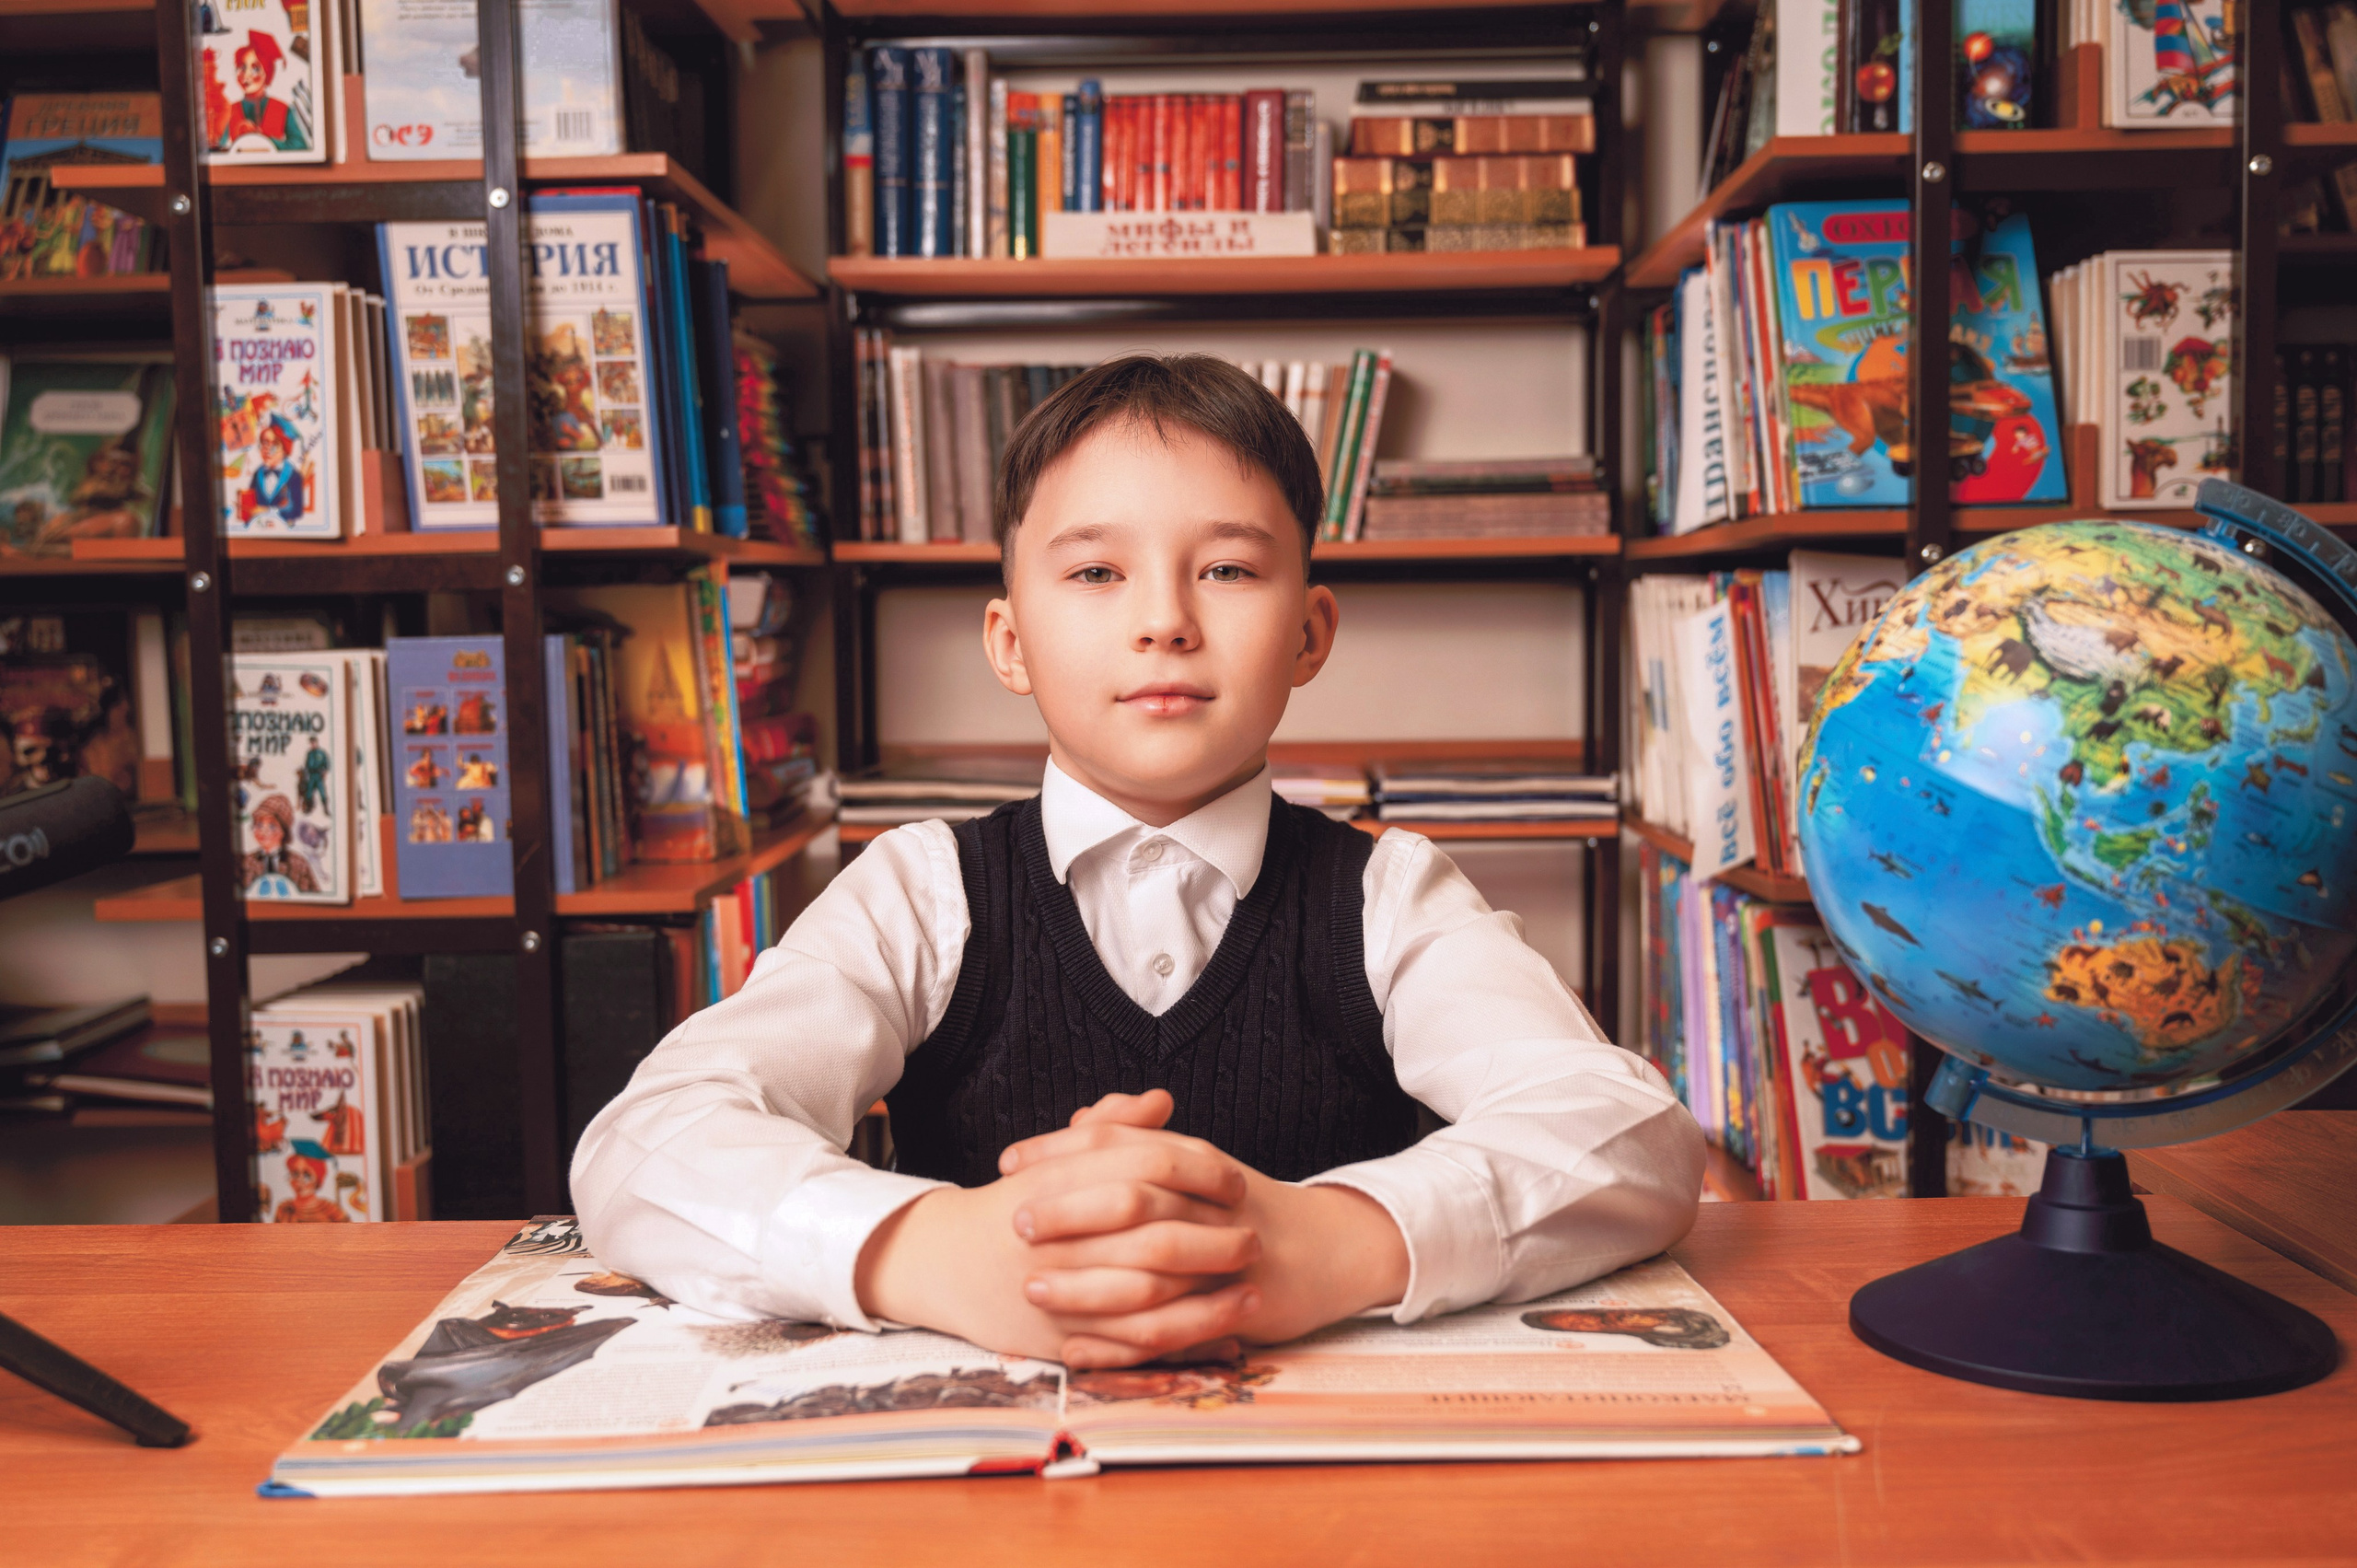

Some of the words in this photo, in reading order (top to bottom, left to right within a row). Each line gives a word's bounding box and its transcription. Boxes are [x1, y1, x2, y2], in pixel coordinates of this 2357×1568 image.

[26, 113, 140, 137] ГРЕЦИЯ
[405, 242, 621, 279] ИСТРИЯ
[1791, 251, 2024, 320] ПЕРАЯ
[229, 339, 316, 361] ПОЗНАЮ
[238, 363, 284, 384] МИР
[233, 710, 326, 734] ПОЗНАЮ
[247, 735, 292, 754] МИР
[1714, 719, 1736, 790] обо
[267, 1066, 355, 1089] ПОЗНАЮ
[279, 1090, 323, 1111] МИР
